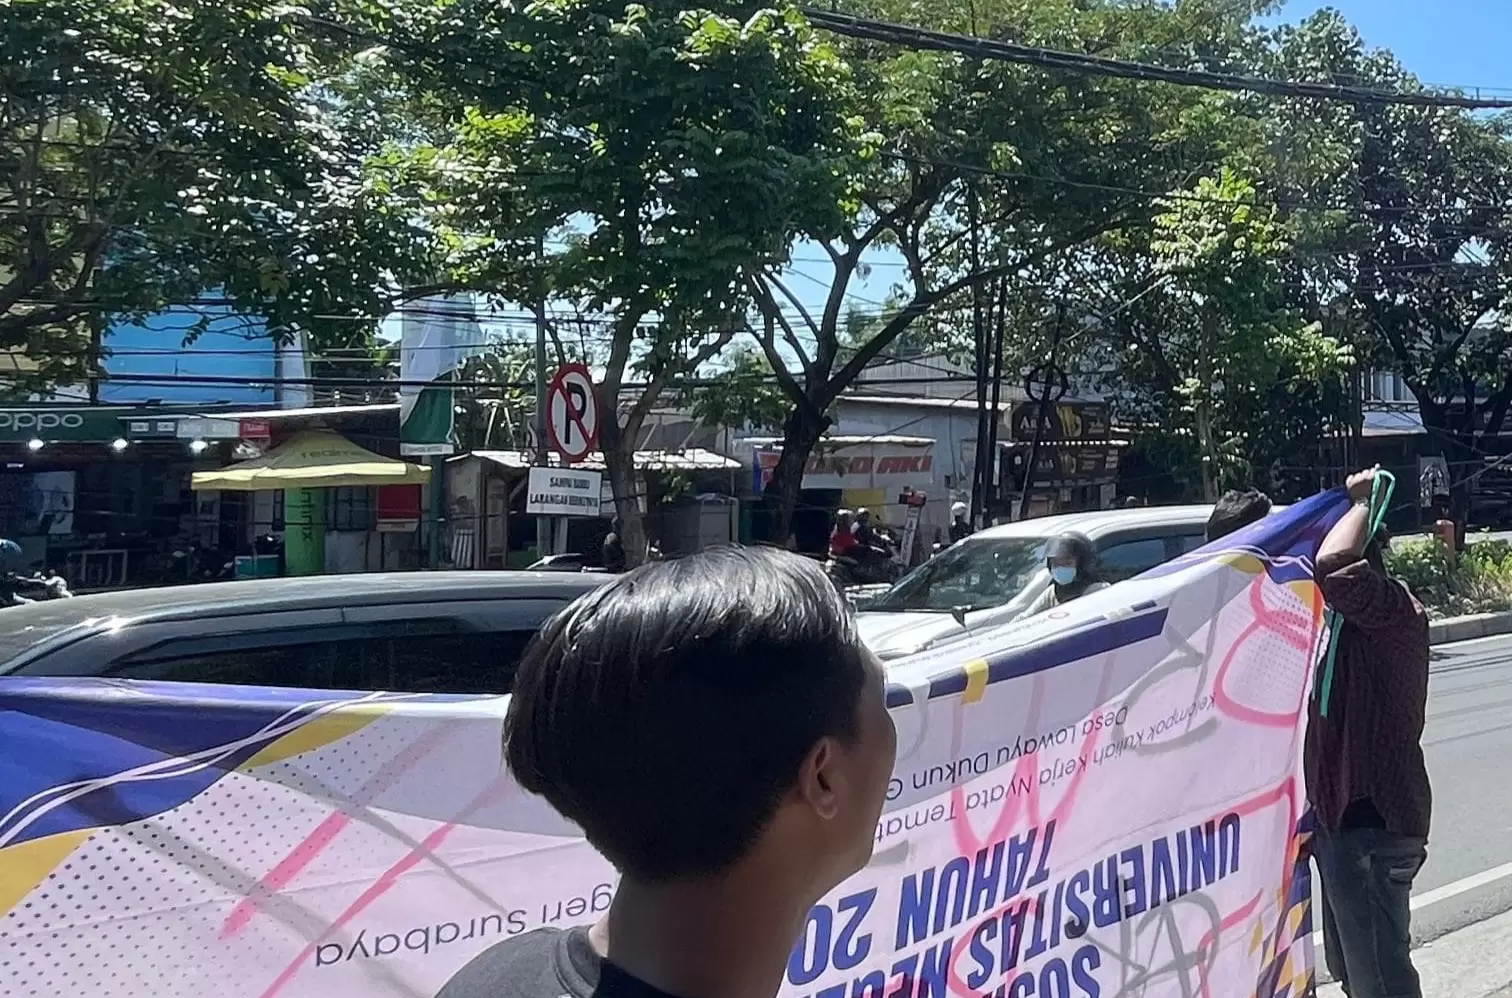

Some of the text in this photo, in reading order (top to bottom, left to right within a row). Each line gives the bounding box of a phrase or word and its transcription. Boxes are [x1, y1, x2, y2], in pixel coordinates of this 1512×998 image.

[565, 381, 586, 444] P
[912, 706, 1128, 786] Desa Lowayu Dukun
[1092, 732, 1144, 767] Kuliah
[966, 774, 1033, 811] Nyata
[1040, 757, 1090, 786] Kerja
[874, 801, 957, 841] Temat
[542, 883, 613, 924] geri
[787, 818, 1058, 987] TAHUN 20
[967, 812, 1241, 991] UNIVERSITAS
[315, 909, 527, 967] Surabaya
